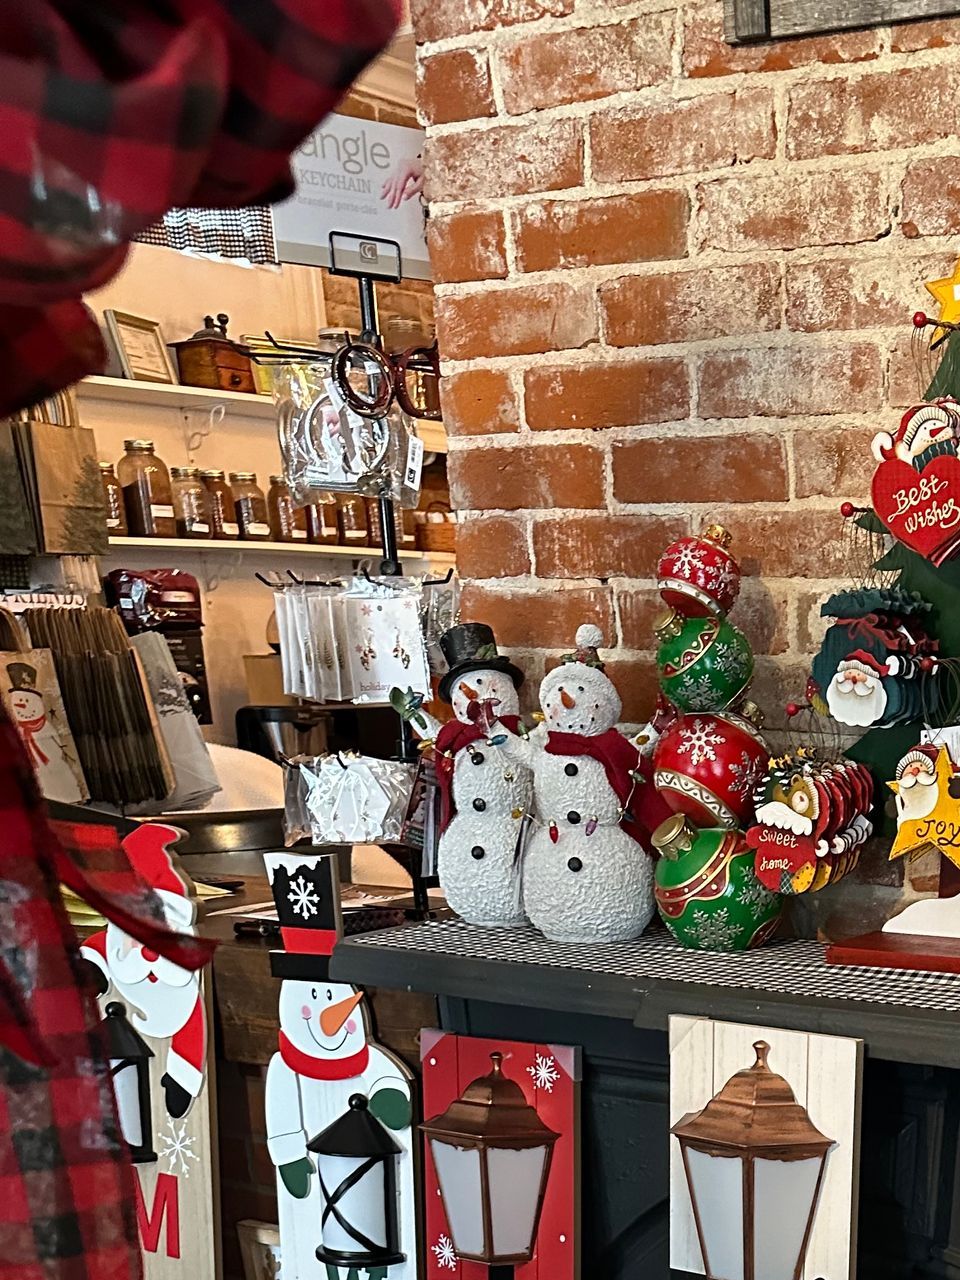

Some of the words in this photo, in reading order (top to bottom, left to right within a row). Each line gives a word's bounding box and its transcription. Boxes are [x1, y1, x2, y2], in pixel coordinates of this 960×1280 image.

[299, 168, 372, 194] KEYCHAIN
[887, 474, 949, 524] Best
[760, 856, 793, 871] home
